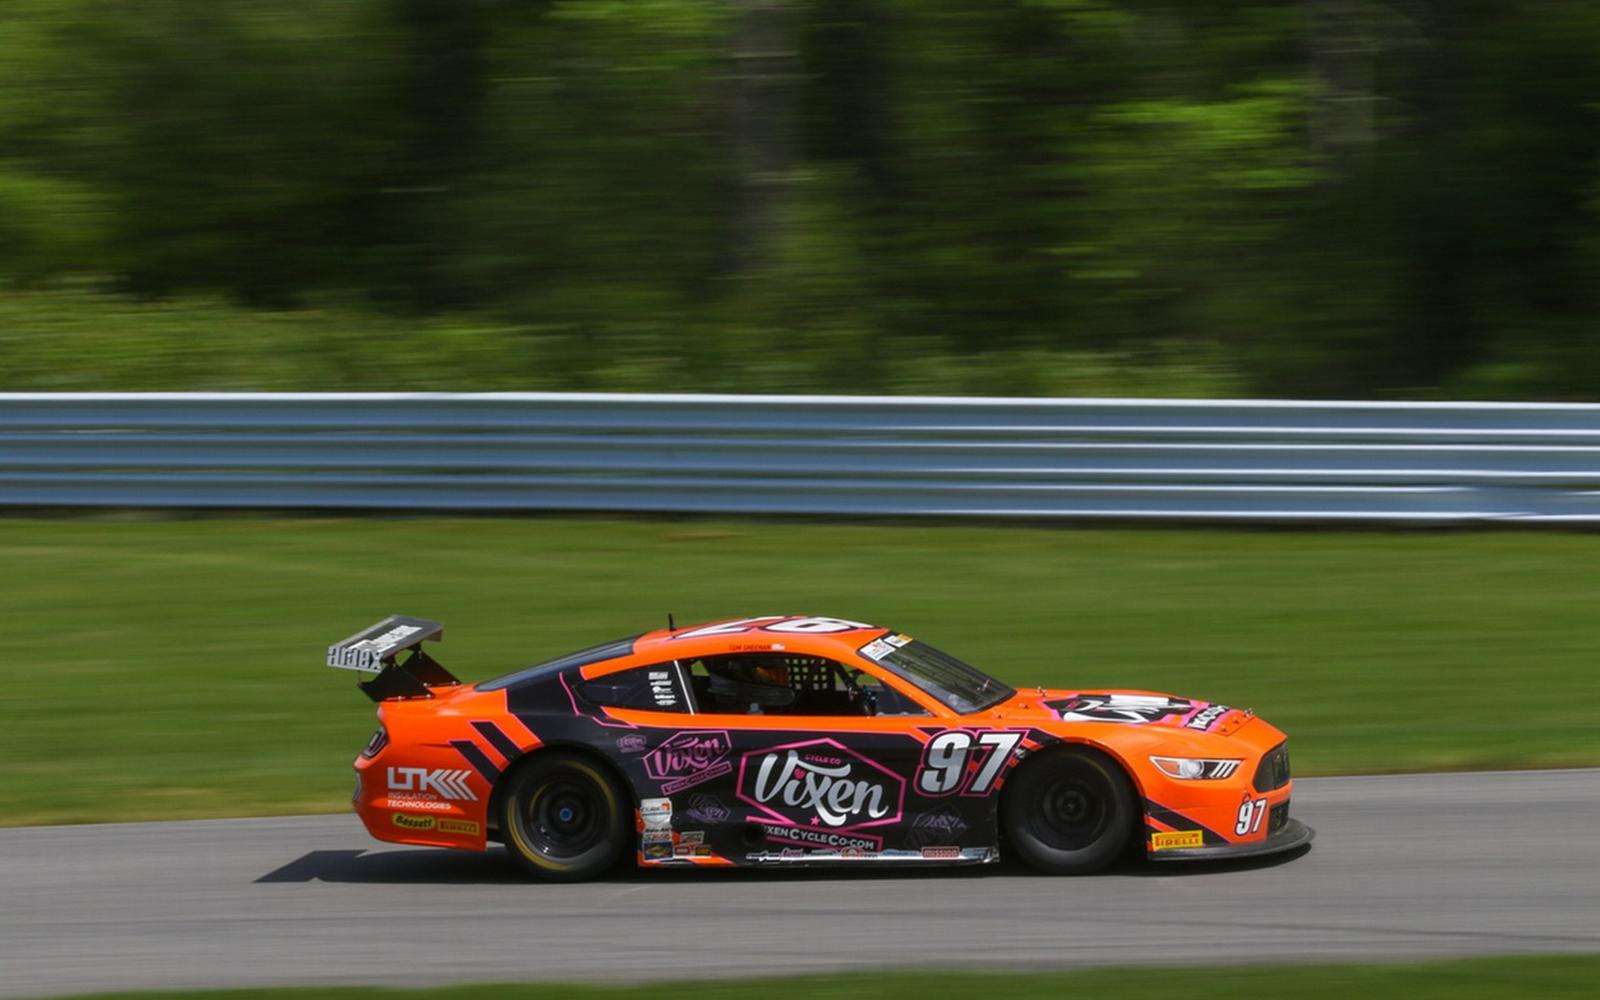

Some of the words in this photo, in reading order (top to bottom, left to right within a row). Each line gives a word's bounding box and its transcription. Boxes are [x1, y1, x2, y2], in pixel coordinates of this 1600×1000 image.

[653, 737, 724, 776] Vixen
[919, 731, 1022, 793] 97
[387, 767, 458, 800] LTK
[754, 750, 889, 826] Vixen
[387, 800, 452, 810] TECHNOLOGIES
[1235, 800, 1267, 835] 97
[1155, 834, 1199, 847] PIRELLI
